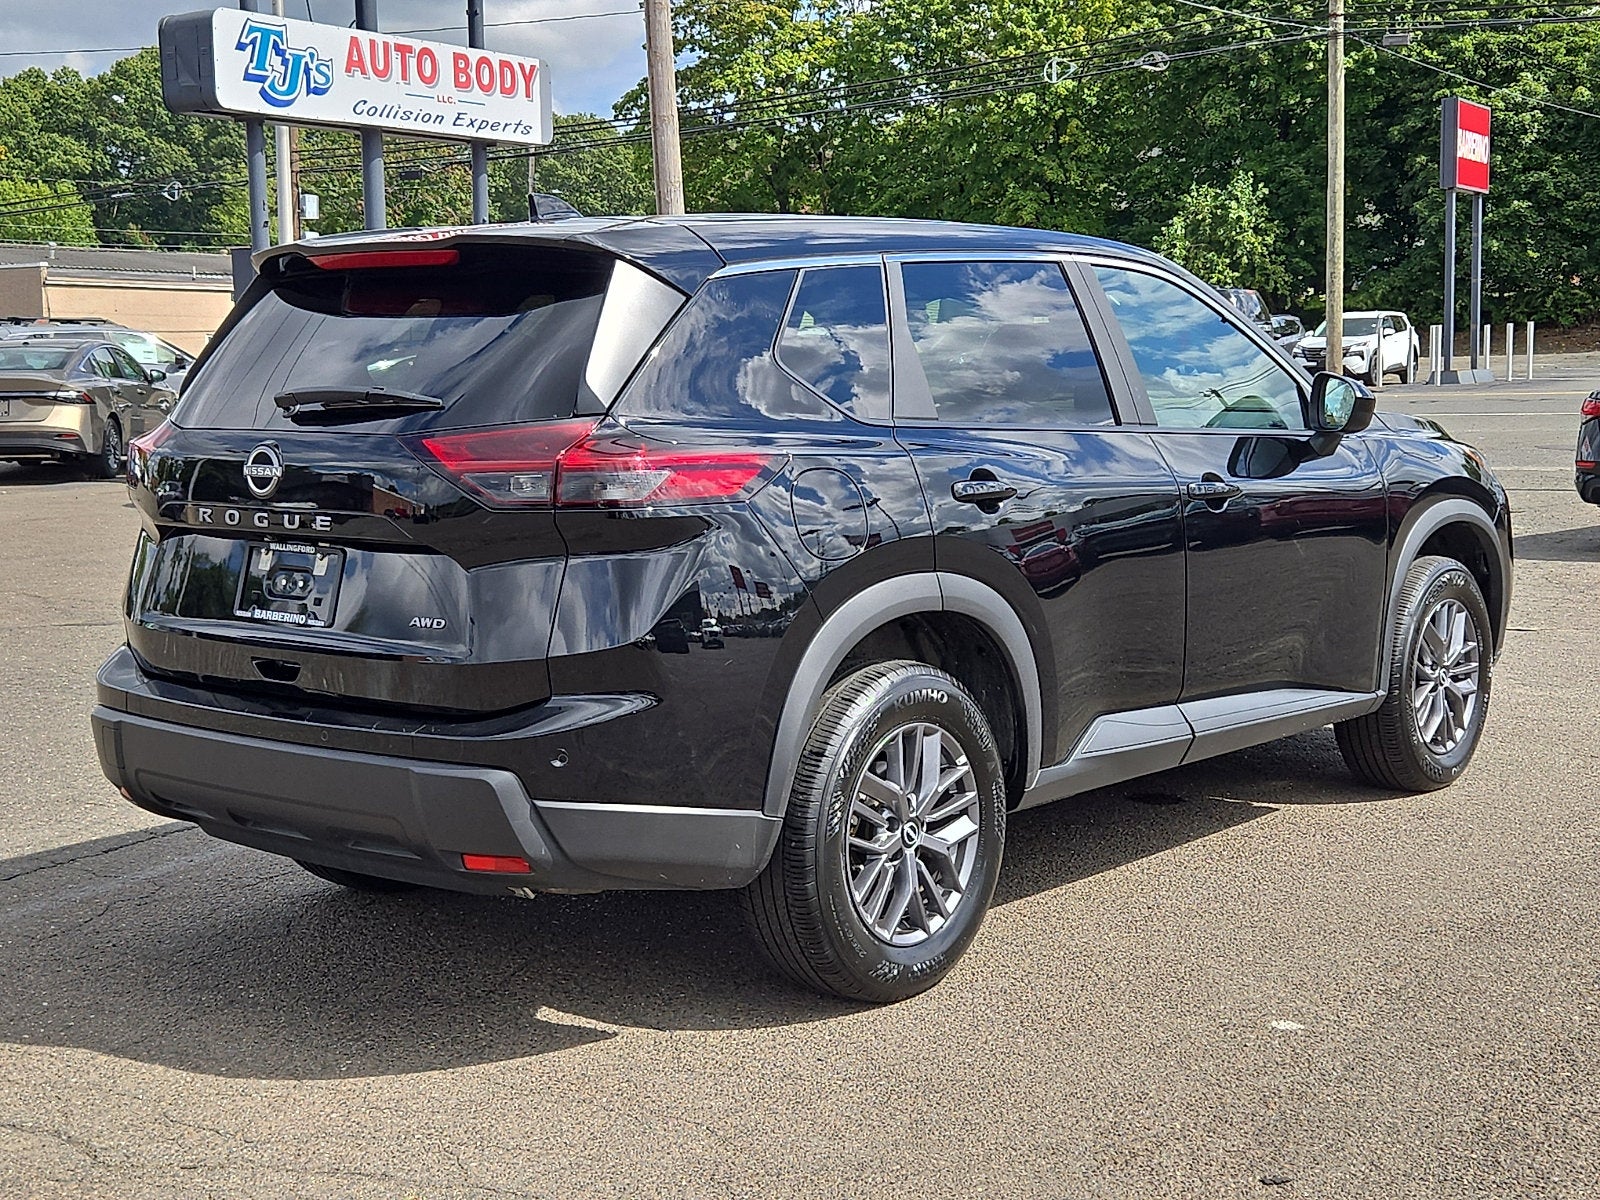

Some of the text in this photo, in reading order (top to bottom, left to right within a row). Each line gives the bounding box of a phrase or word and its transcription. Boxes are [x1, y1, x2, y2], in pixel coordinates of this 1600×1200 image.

[345, 36, 438, 86] AUTO
[453, 52, 539, 101] BODY
[437, 95, 456, 104] LLC.
[352, 99, 532, 136] Collision Experts
[244, 466, 282, 477] NISSAN
[199, 507, 332, 531] ROGUE
[269, 543, 315, 553] WALLINGFORD
[254, 609, 306, 624] BARBERINO
[408, 617, 447, 629] AWD
[895, 689, 948, 711] KUMHO
